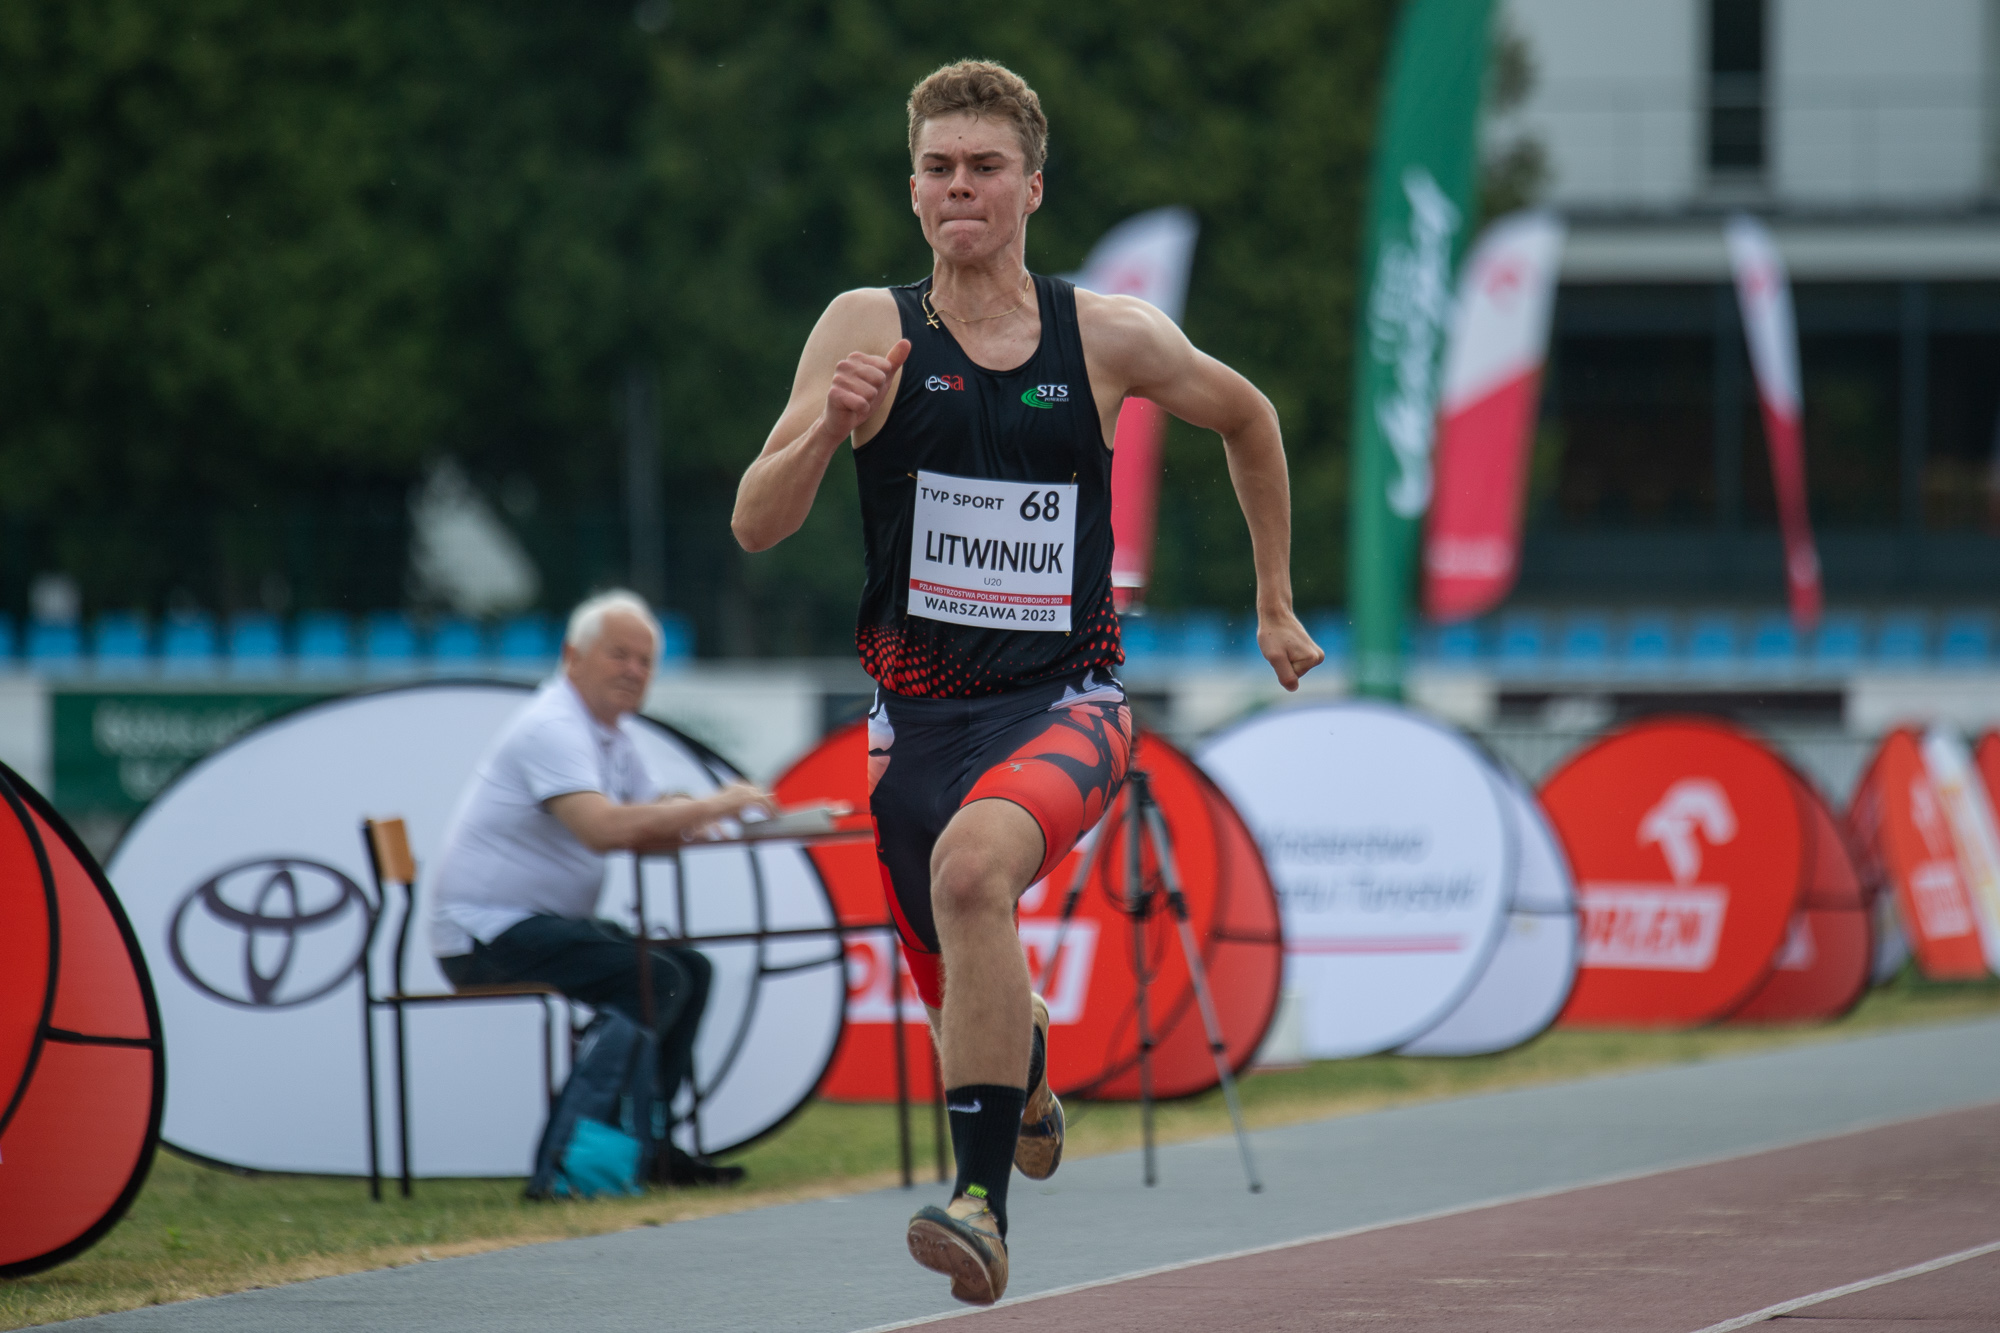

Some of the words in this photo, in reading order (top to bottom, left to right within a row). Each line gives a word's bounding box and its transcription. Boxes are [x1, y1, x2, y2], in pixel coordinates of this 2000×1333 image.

[925, 375, 964, 392] esa
[1037, 385, 1068, 397] STS
[921, 487, 949, 502] TVP
[953, 493, 1004, 511] SPORT
[1019, 491, 1060, 522] 68
[925, 530, 1064, 574] LITWINIUK
[983, 577, 1002, 587] U20
[919, 583, 933, 591] PZLA
[933, 586, 976, 599] MISTRZOSTWA
[977, 593, 999, 602] POLSKI
[1008, 596, 1050, 604] WIELOBOJACH
[925, 596, 1017, 621] WARSZAWA
[1021, 609, 1056, 622] 2023
[967, 1184, 988, 1198] NIKE
